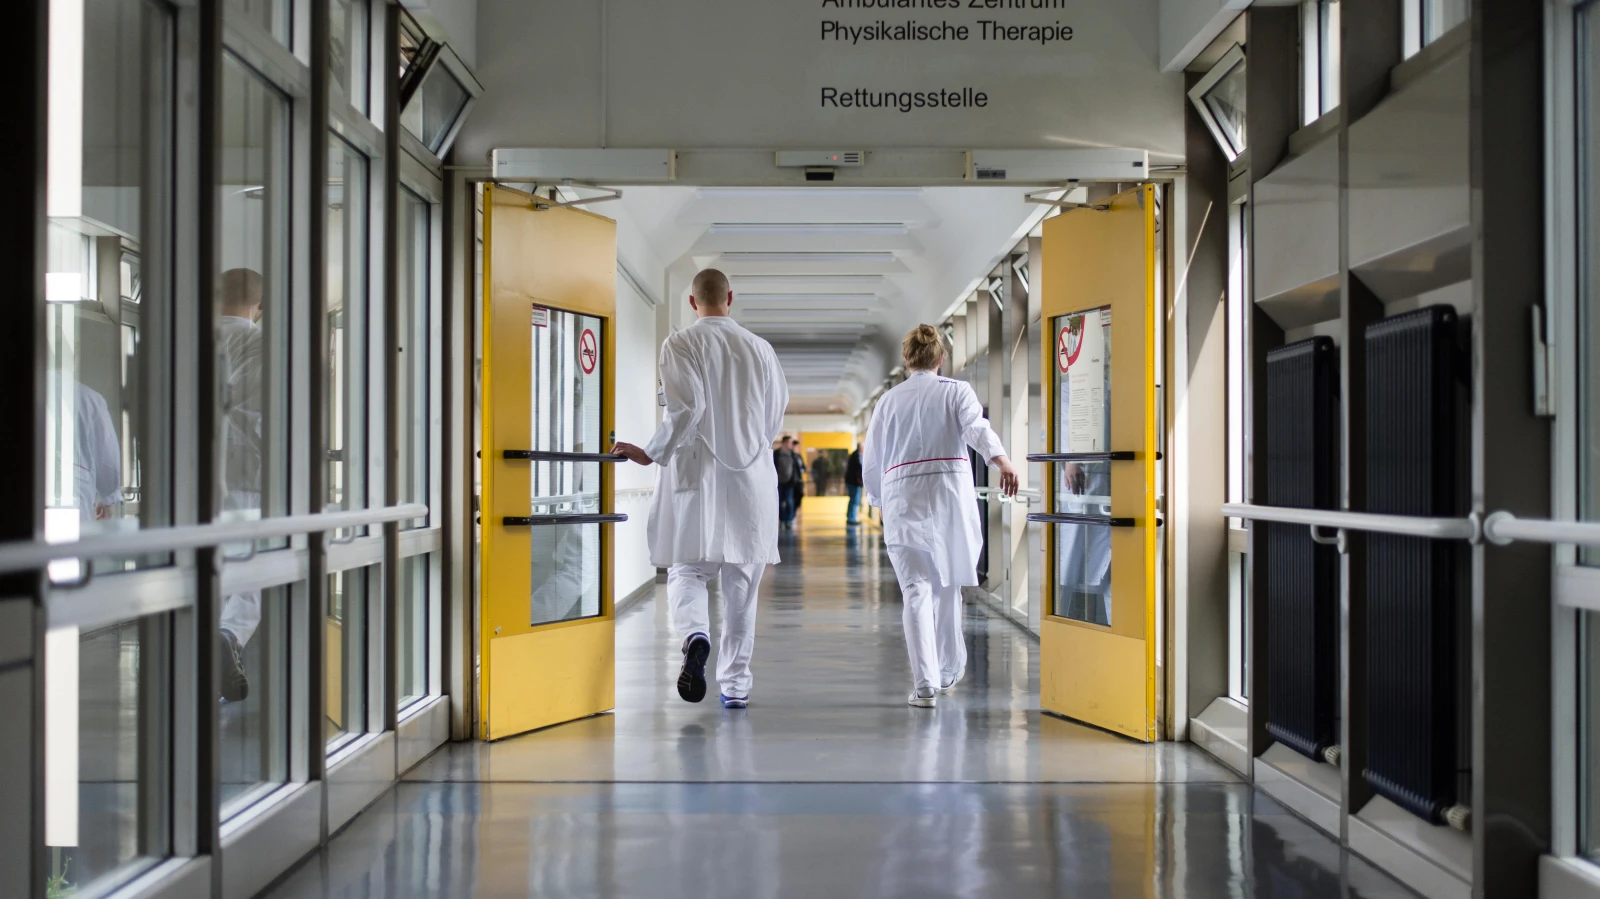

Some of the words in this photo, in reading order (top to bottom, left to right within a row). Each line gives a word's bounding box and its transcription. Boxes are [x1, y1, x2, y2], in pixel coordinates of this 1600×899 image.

[822, 20, 969, 46] Physikalische
[977, 20, 1074, 46] Therapie
[822, 87, 988, 113] Rettungsstelle
